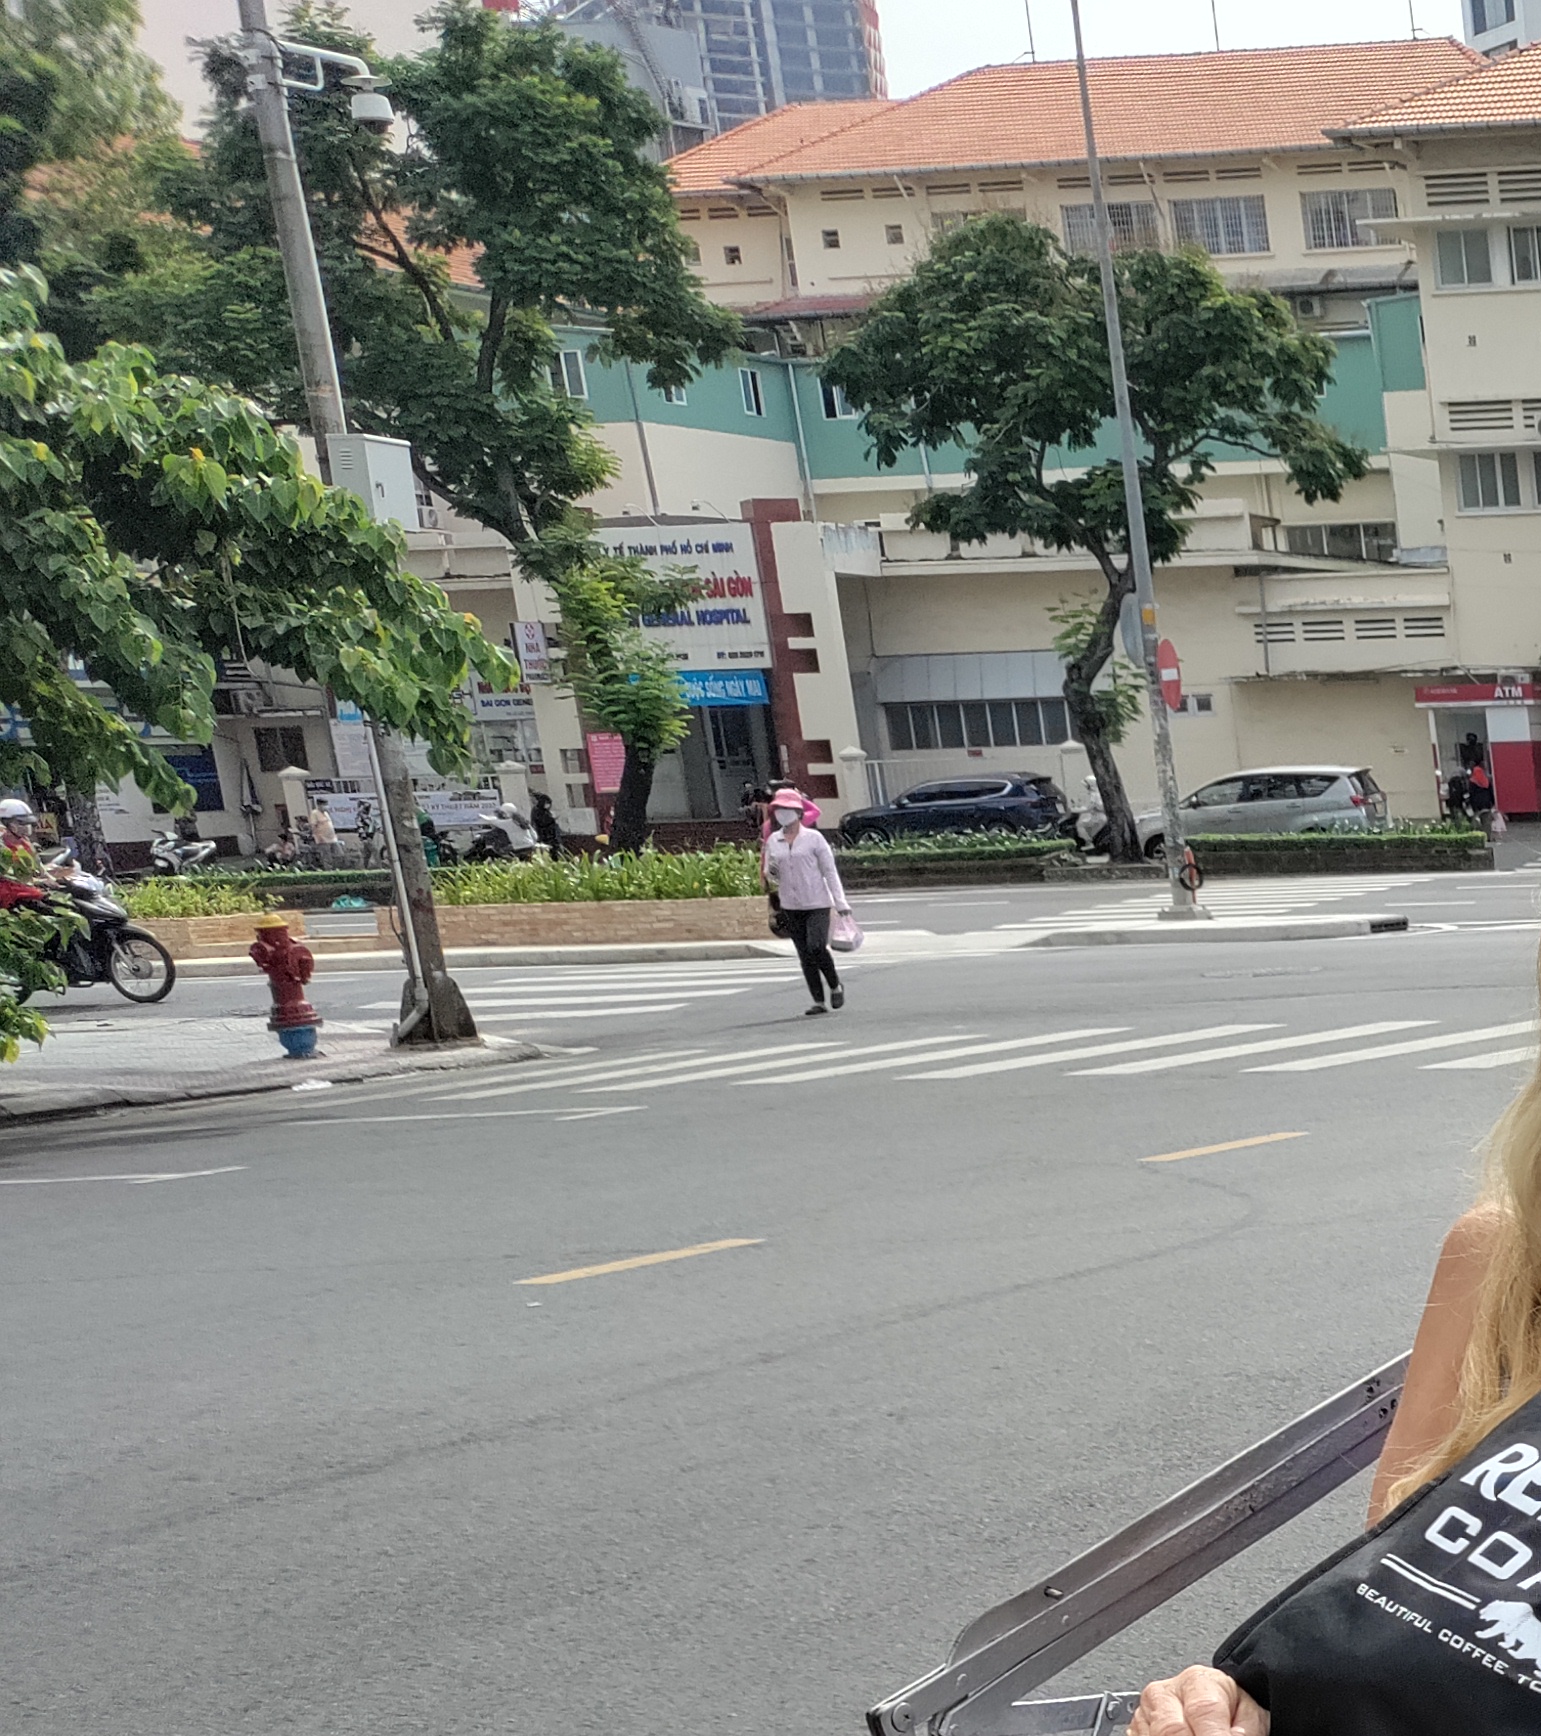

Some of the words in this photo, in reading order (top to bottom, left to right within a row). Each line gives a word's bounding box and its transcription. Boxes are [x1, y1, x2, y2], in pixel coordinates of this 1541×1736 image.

[704, 570, 725, 599] SÀI
[727, 569, 754, 599] GÒN
[696, 607, 751, 626] HOSPITAL
[1493, 685, 1523, 698] ATM
[1355, 1582, 1434, 1635] BEAUTIFUL
[1437, 1628, 1508, 1676] COFFEE
